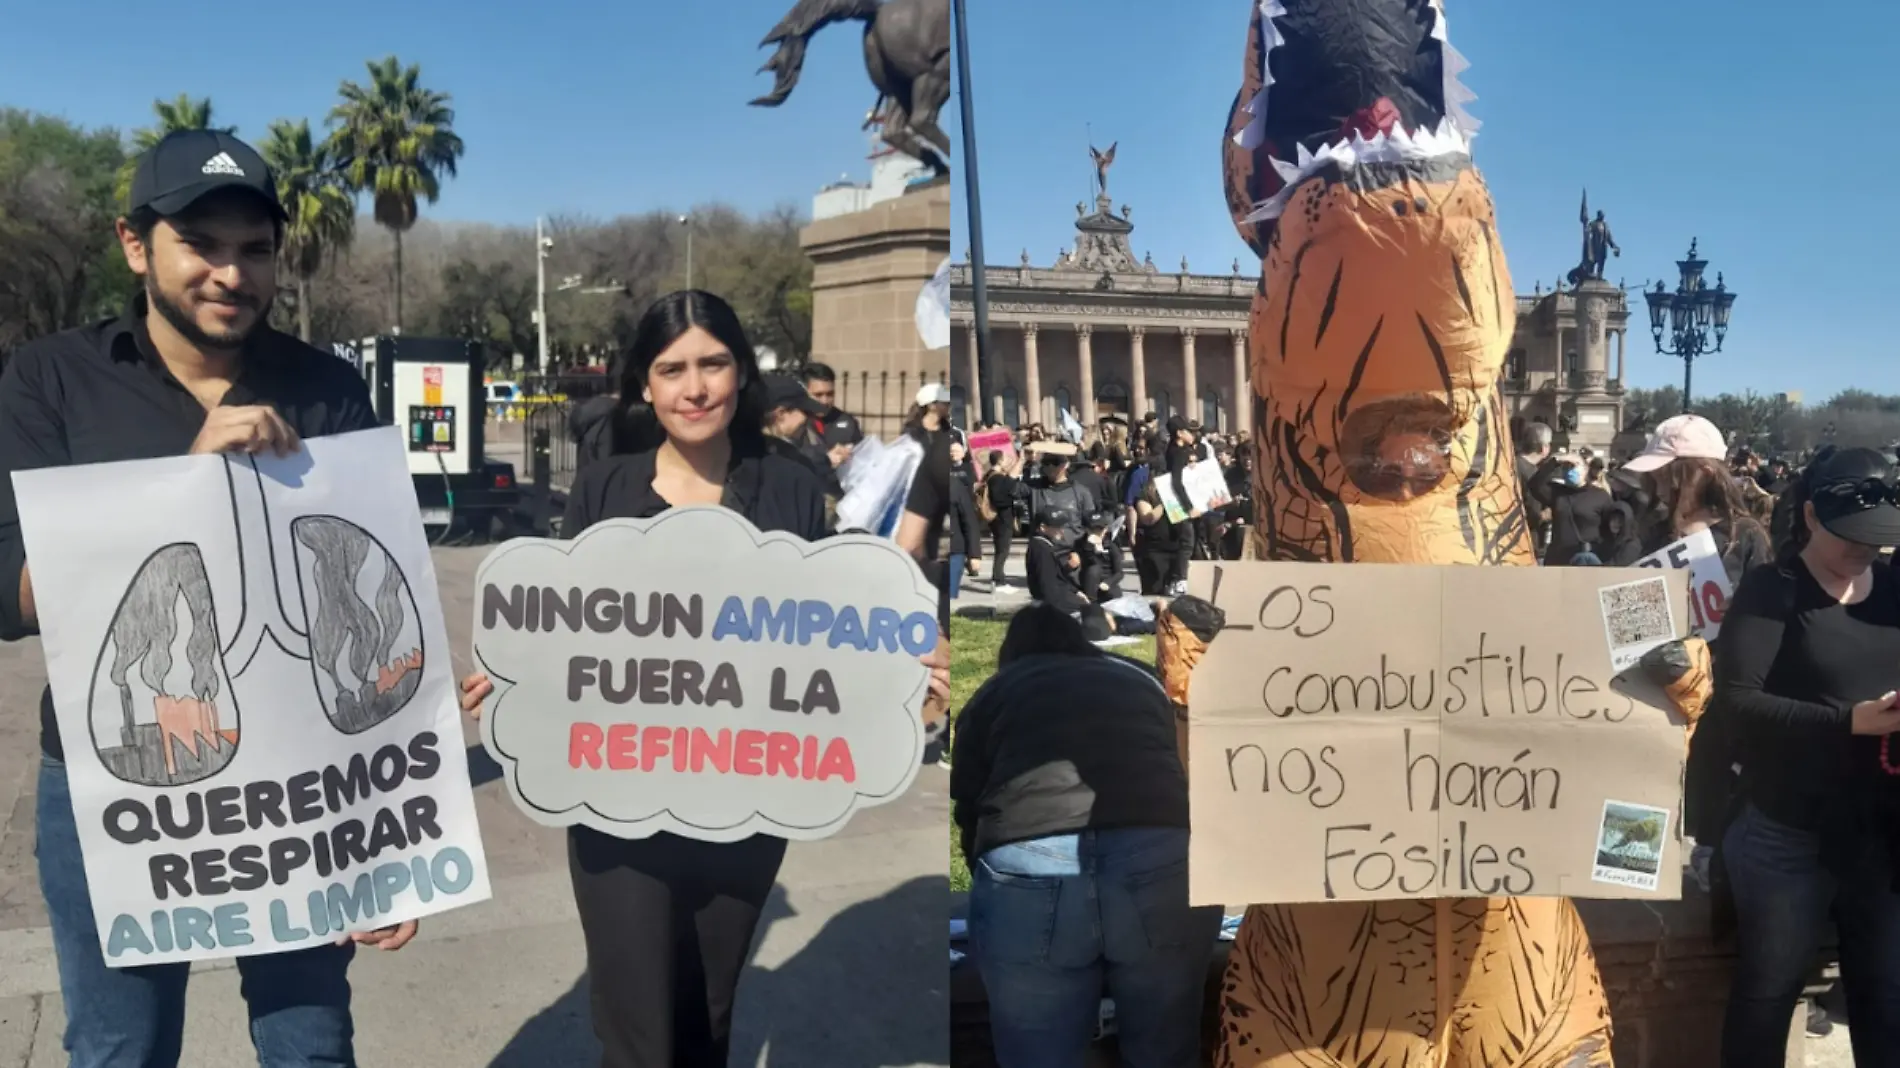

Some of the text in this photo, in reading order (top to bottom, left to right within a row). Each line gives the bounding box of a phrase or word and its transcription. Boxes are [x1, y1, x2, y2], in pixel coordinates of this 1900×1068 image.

[202, 164, 245, 177] adidas
[481, 583, 939, 657] NINGUN AMPARO
[567, 655, 841, 715] FUERA LA
[1263, 631, 1634, 723] combustibles
[102, 731, 441, 844] QUEREMOS
[568, 721, 856, 783] REFINERIA
[1225, 728, 1562, 811] nos harán
[148, 795, 443, 900] RESPIRAR
[1324, 820, 1535, 898] Fósiles
[106, 846, 474, 957] AIRE LIMPIO
